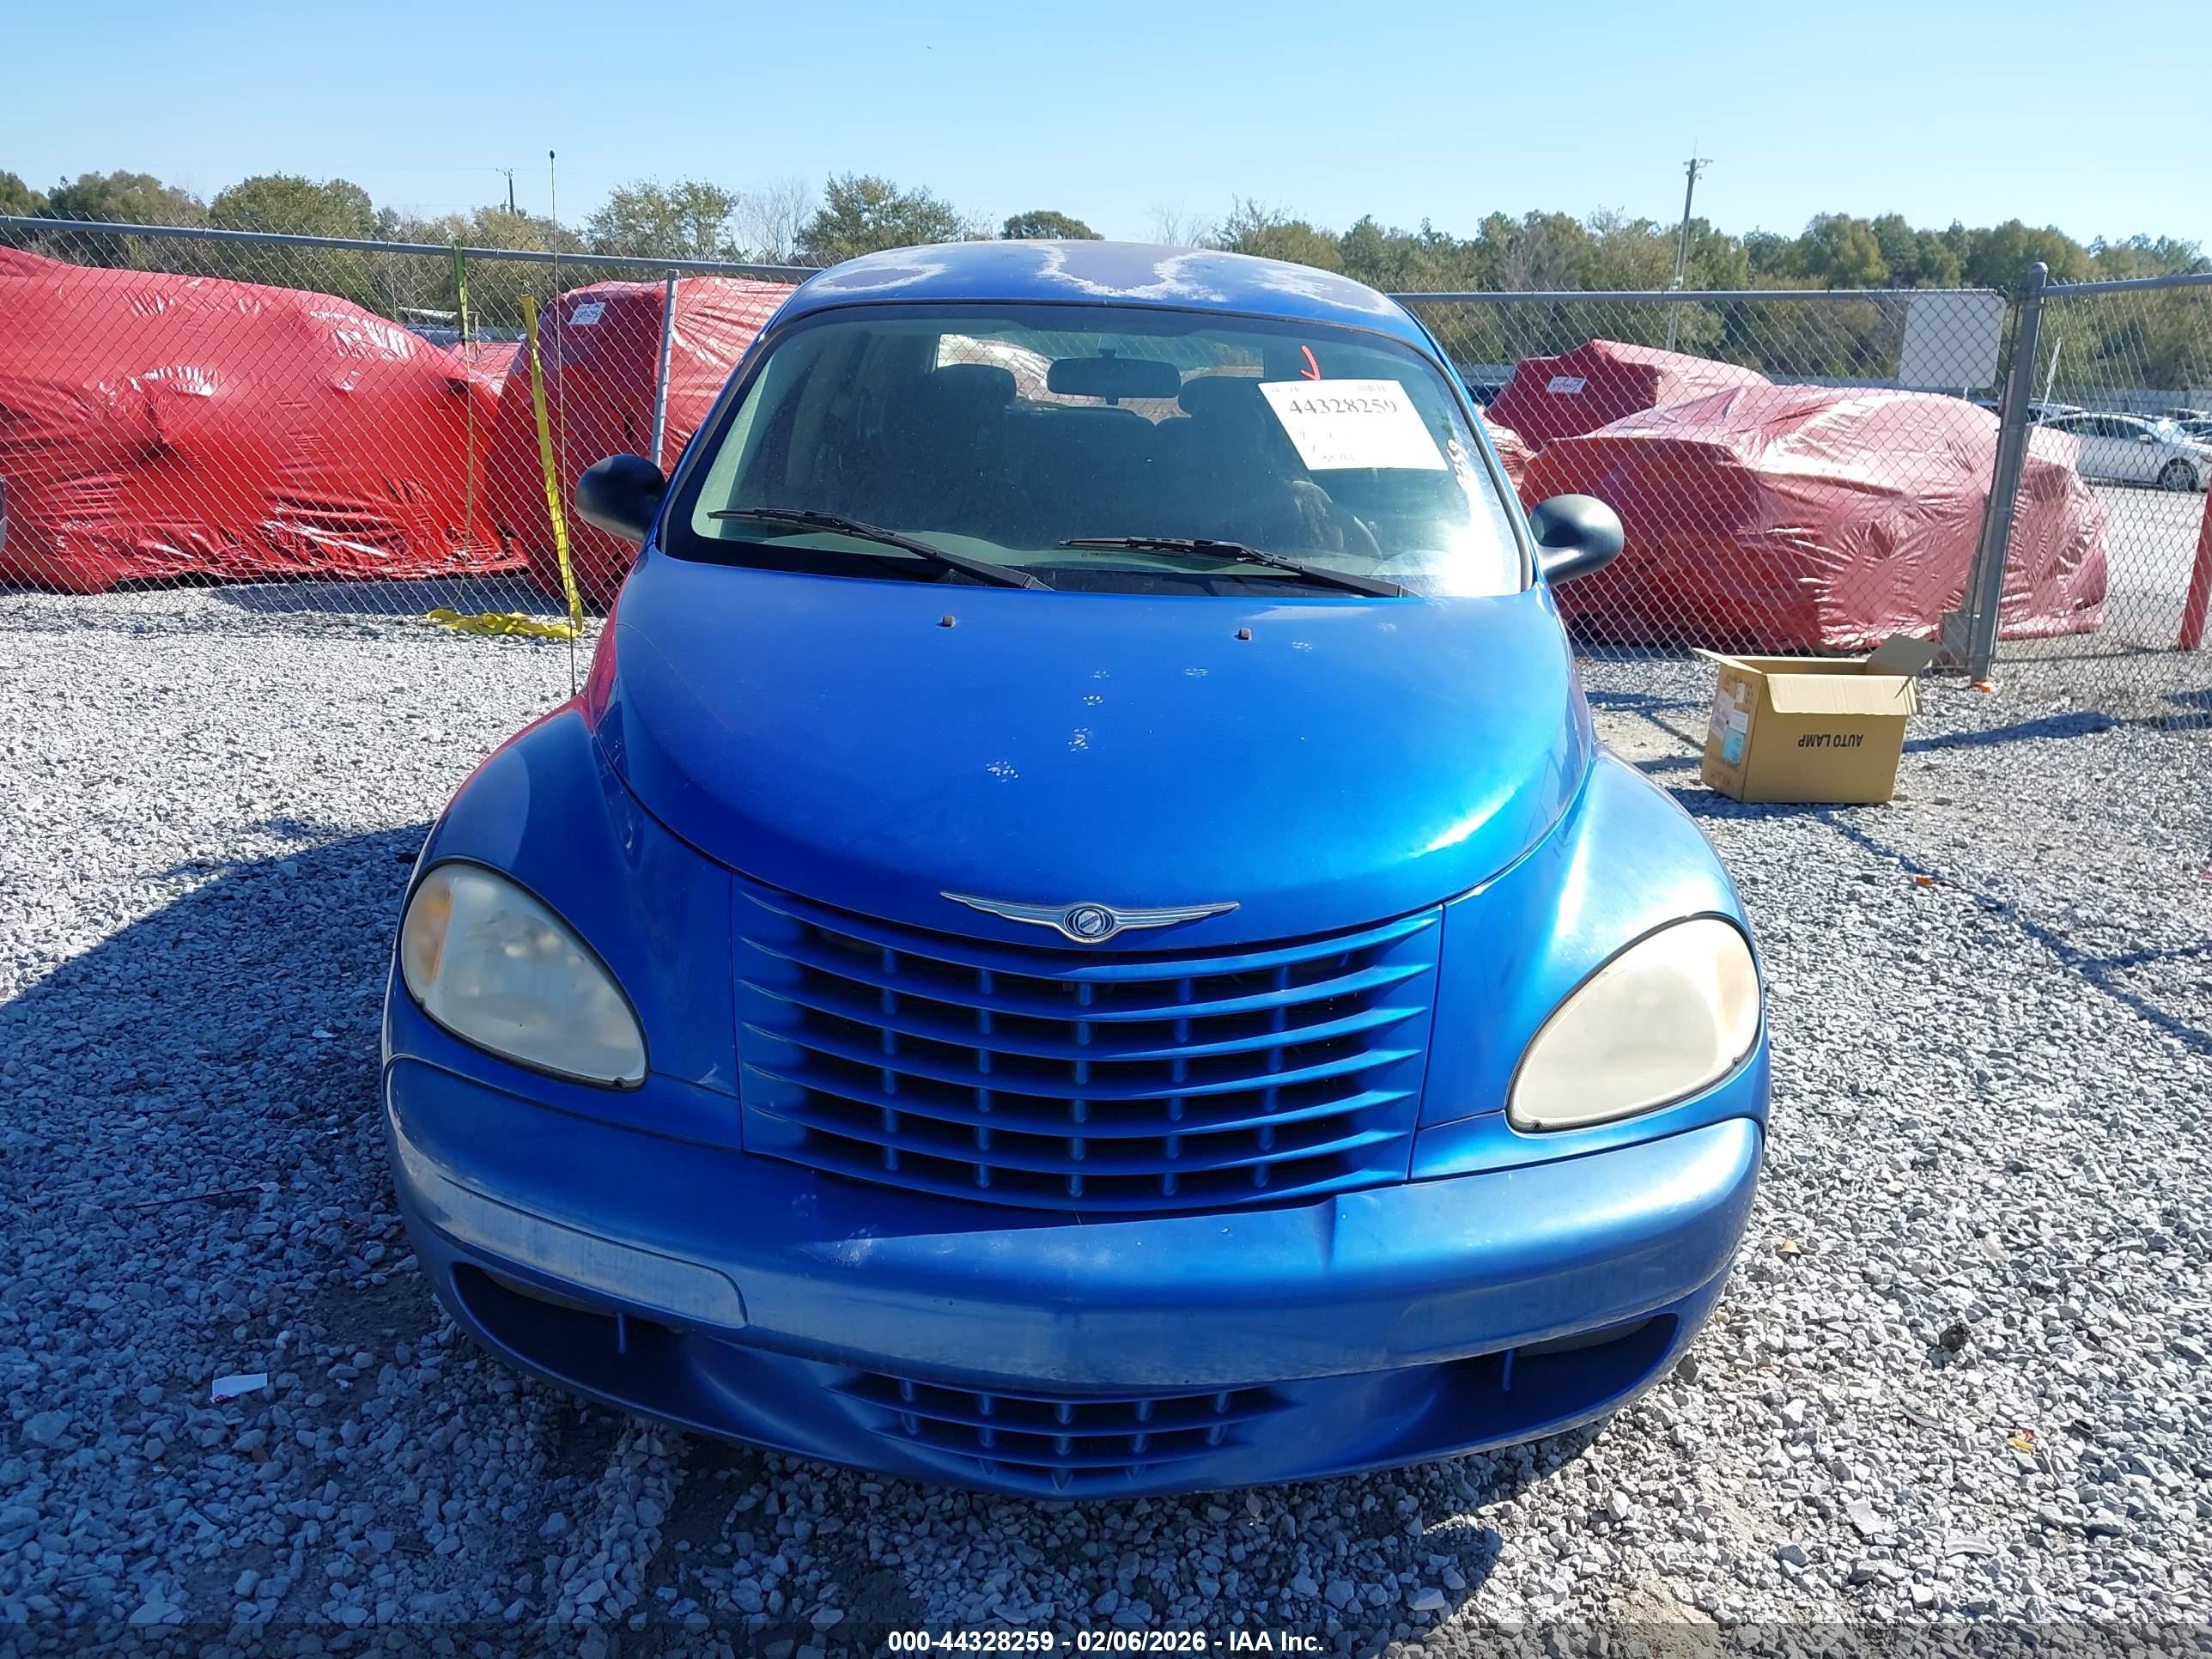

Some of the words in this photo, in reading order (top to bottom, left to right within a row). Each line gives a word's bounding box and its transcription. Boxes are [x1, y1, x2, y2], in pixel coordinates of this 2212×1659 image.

[1290, 398, 1398, 414] 44328259
[1798, 734, 1831, 748] LAMP
[1833, 734, 1863, 748] AUTO
